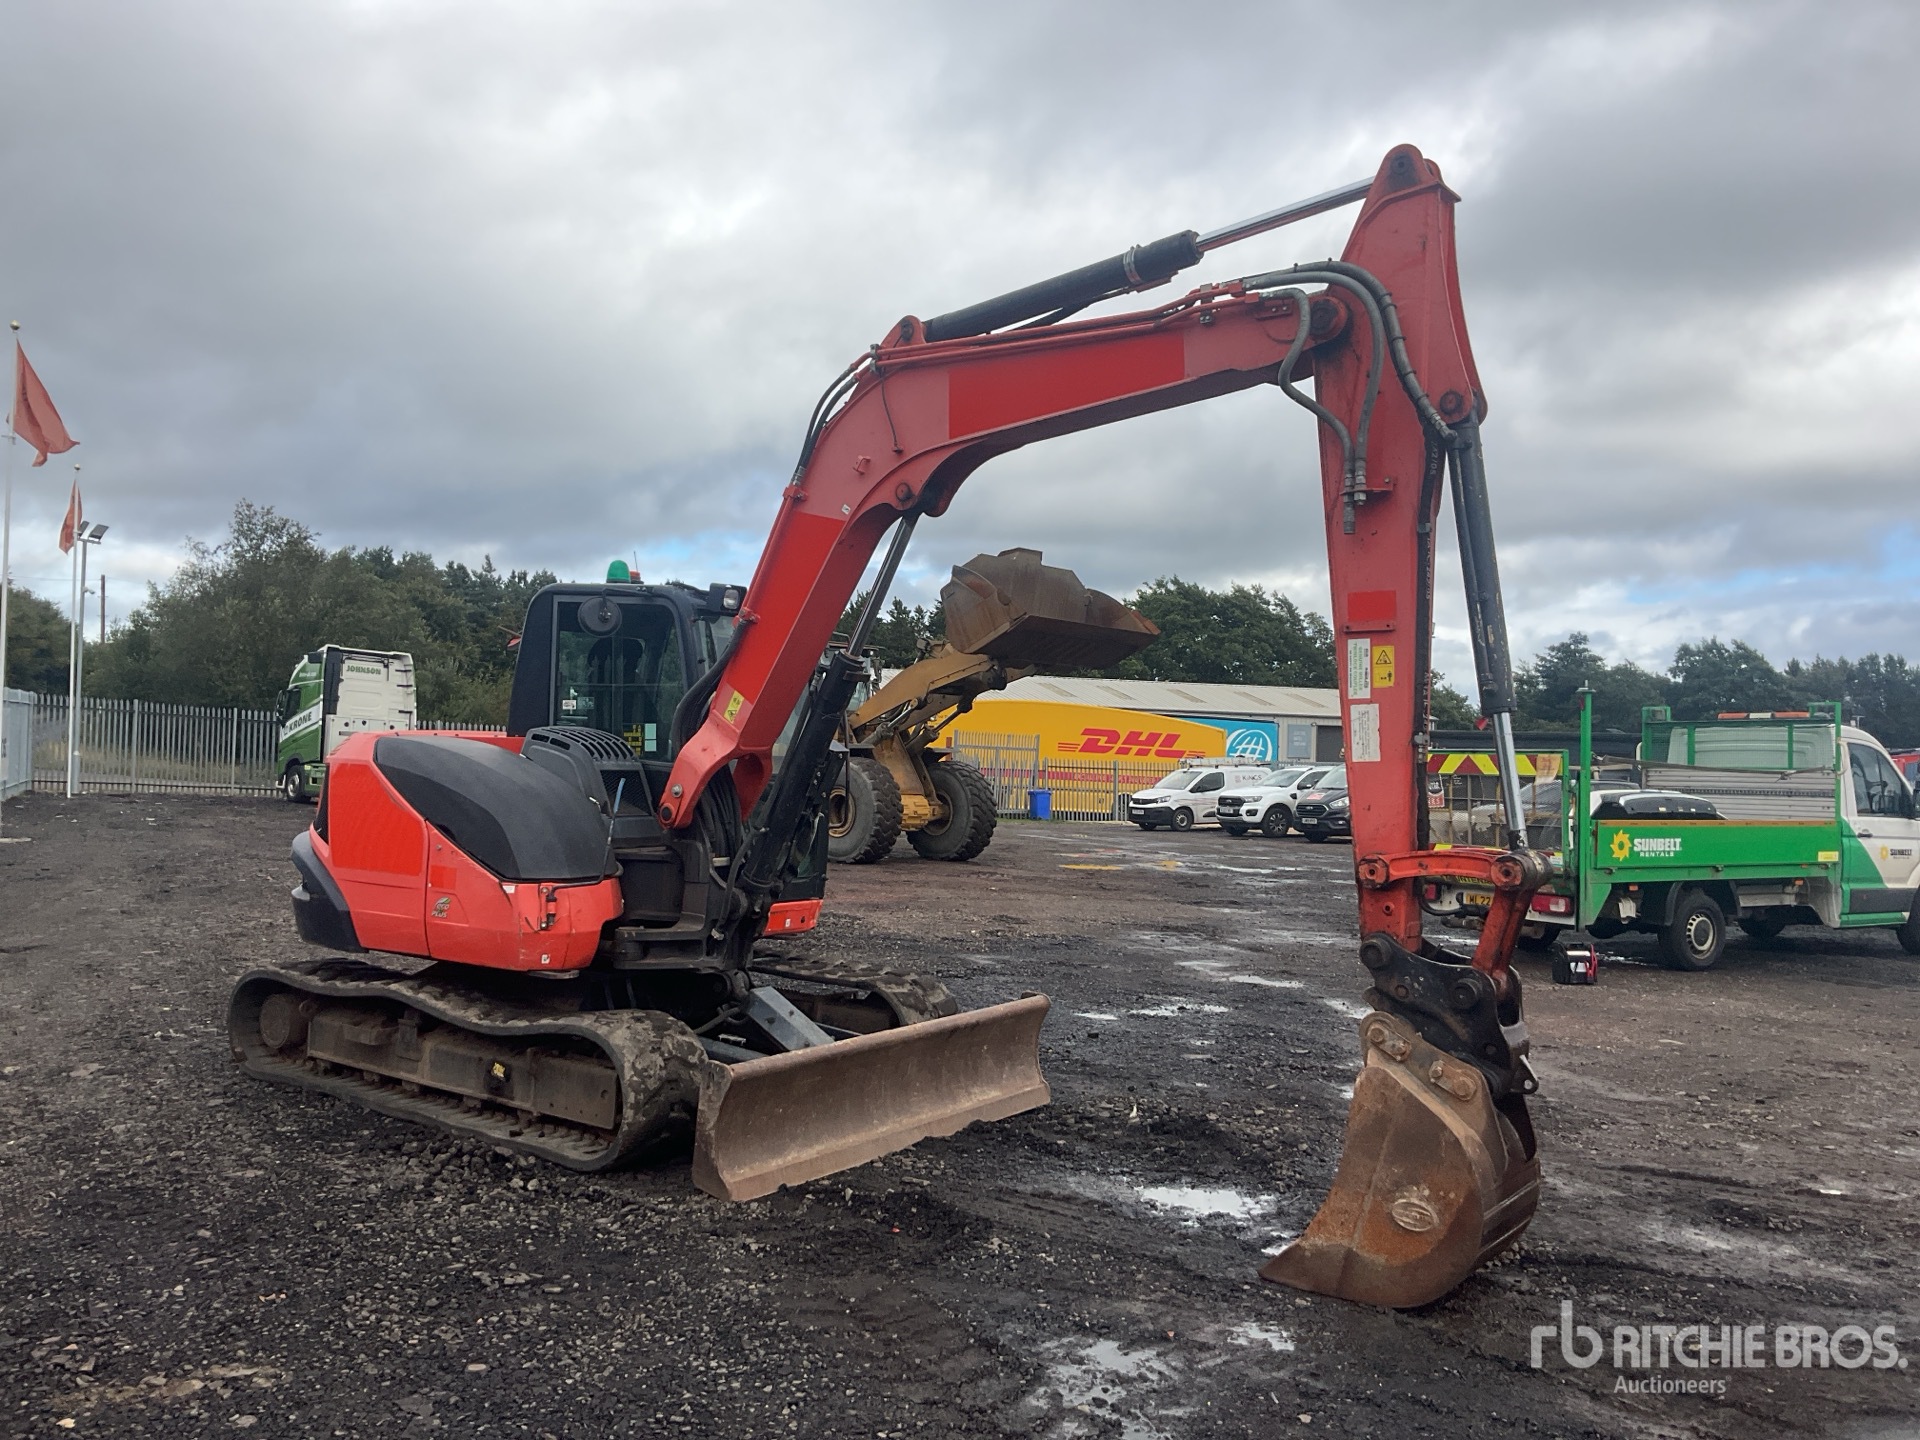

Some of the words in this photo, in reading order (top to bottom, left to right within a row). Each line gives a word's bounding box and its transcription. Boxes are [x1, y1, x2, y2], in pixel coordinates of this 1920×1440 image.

[346, 665, 382, 675] JOHNSON
[289, 711, 312, 730] KRONE
[1078, 728, 1187, 758] DHL
[1633, 838, 1682, 851] SUNBELT
